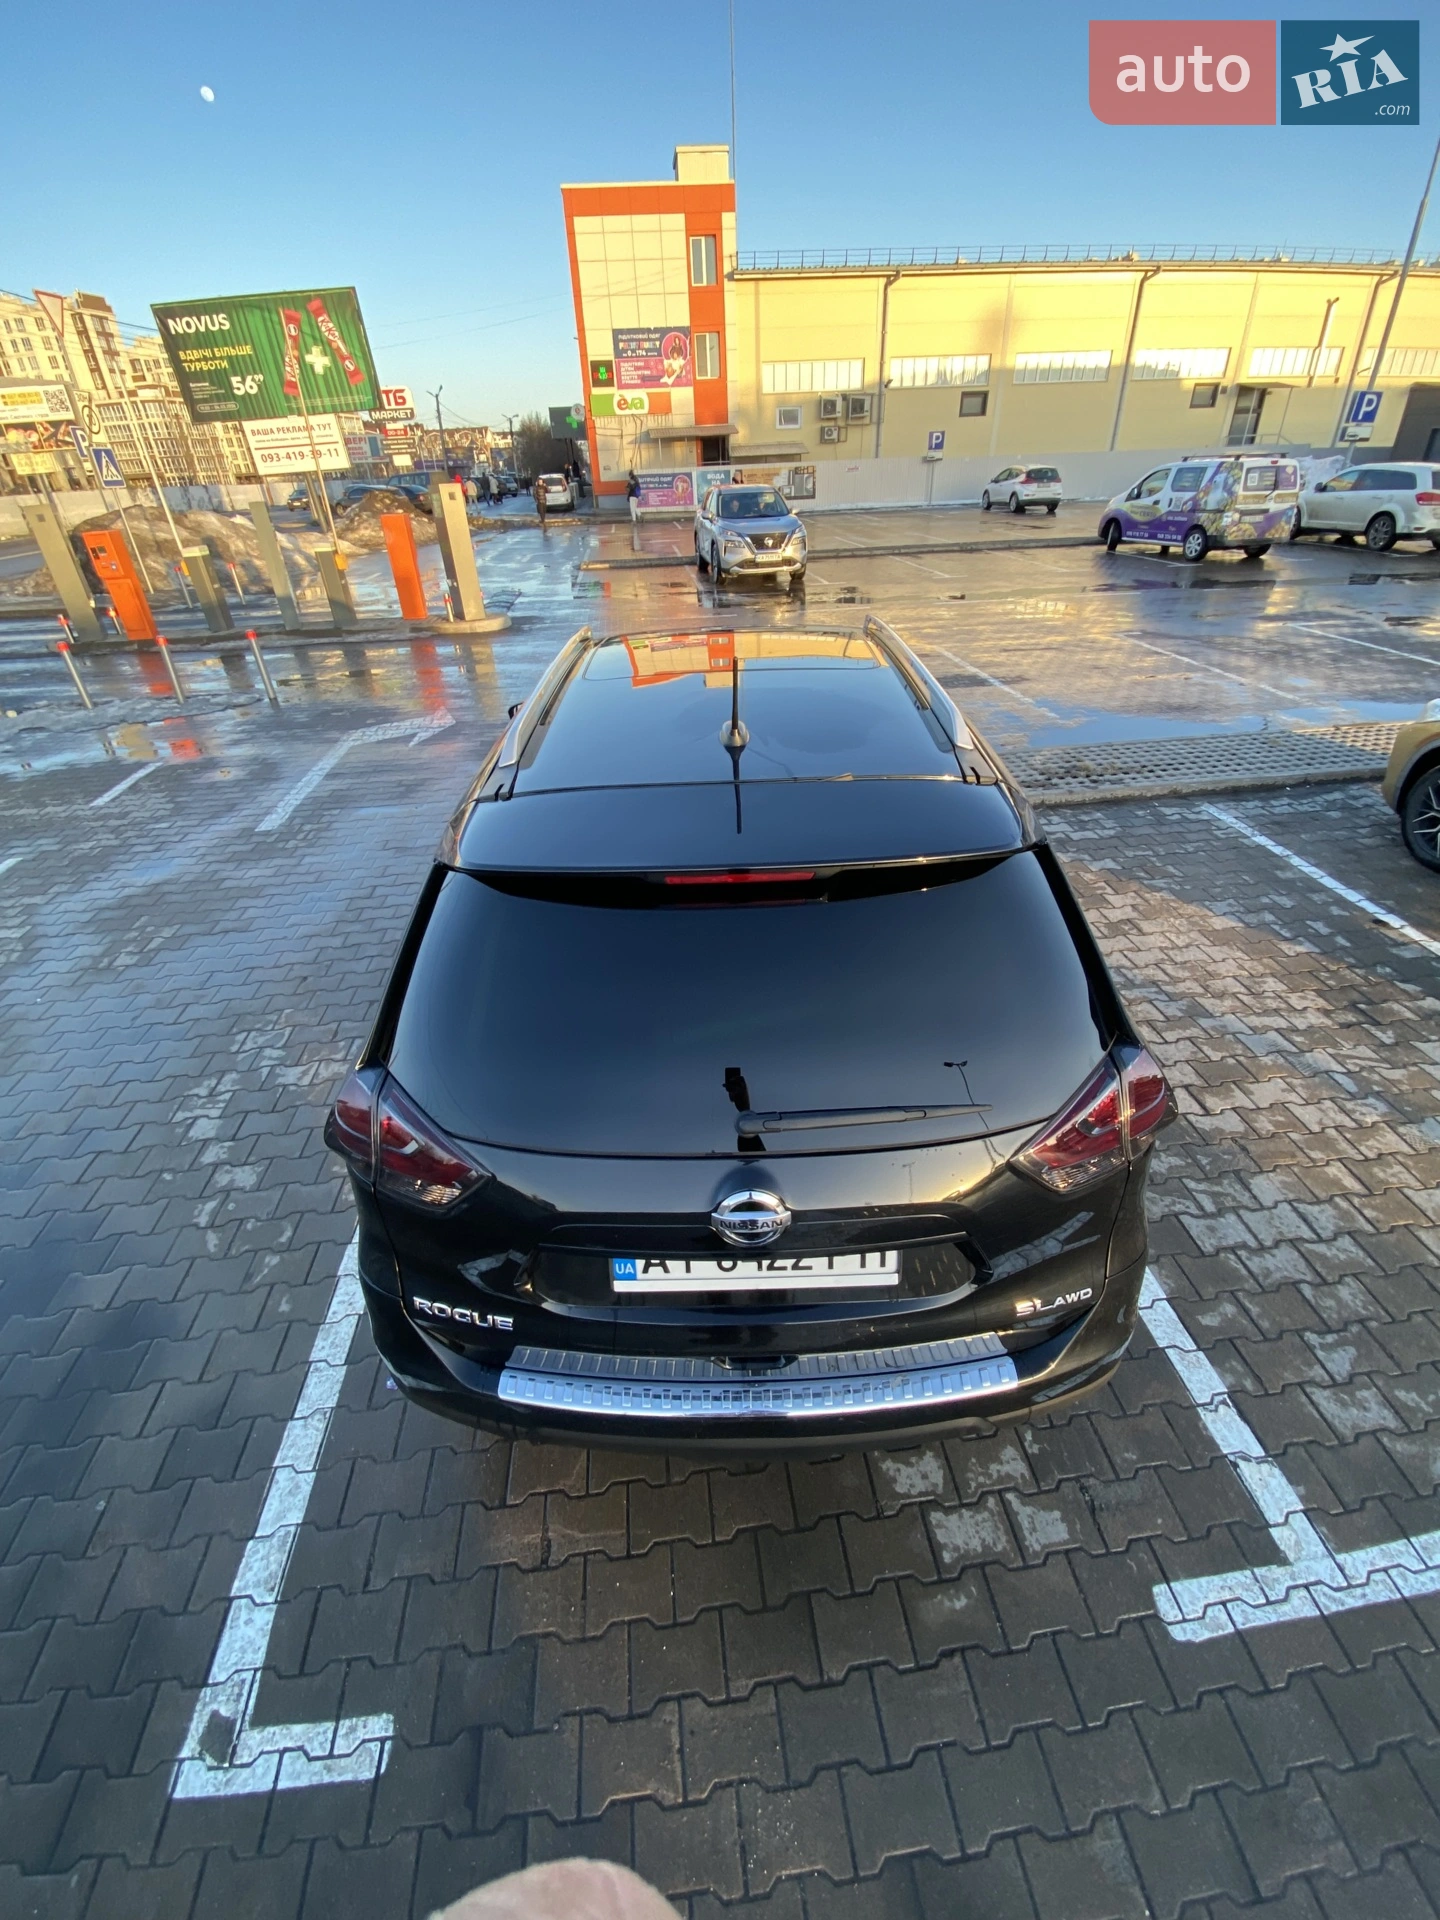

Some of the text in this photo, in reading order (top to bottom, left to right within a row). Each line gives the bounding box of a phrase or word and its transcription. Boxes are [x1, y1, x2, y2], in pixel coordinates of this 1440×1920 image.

[167, 313, 231, 335] NOVUS
[178, 345, 253, 361] ВДВІЧІ БІЛЬШЕ
[182, 359, 229, 372] ТУРБОТИ
[381, 388, 407, 407] ТБ
[371, 409, 412, 420] МАРКЕТ
[1357, 394, 1378, 421] P
[250, 423, 332, 437] ВАША РЕКЛАМА ТУТ
[932, 432, 942, 449] P
[260, 448, 340, 463] 093-419-39-11
[720, 1218, 784, 1231] NISSAN
[615, 1262, 635, 1275] UA
[1053, 1287, 1093, 1308] AWD
[412, 1296, 514, 1332] ROGUE
